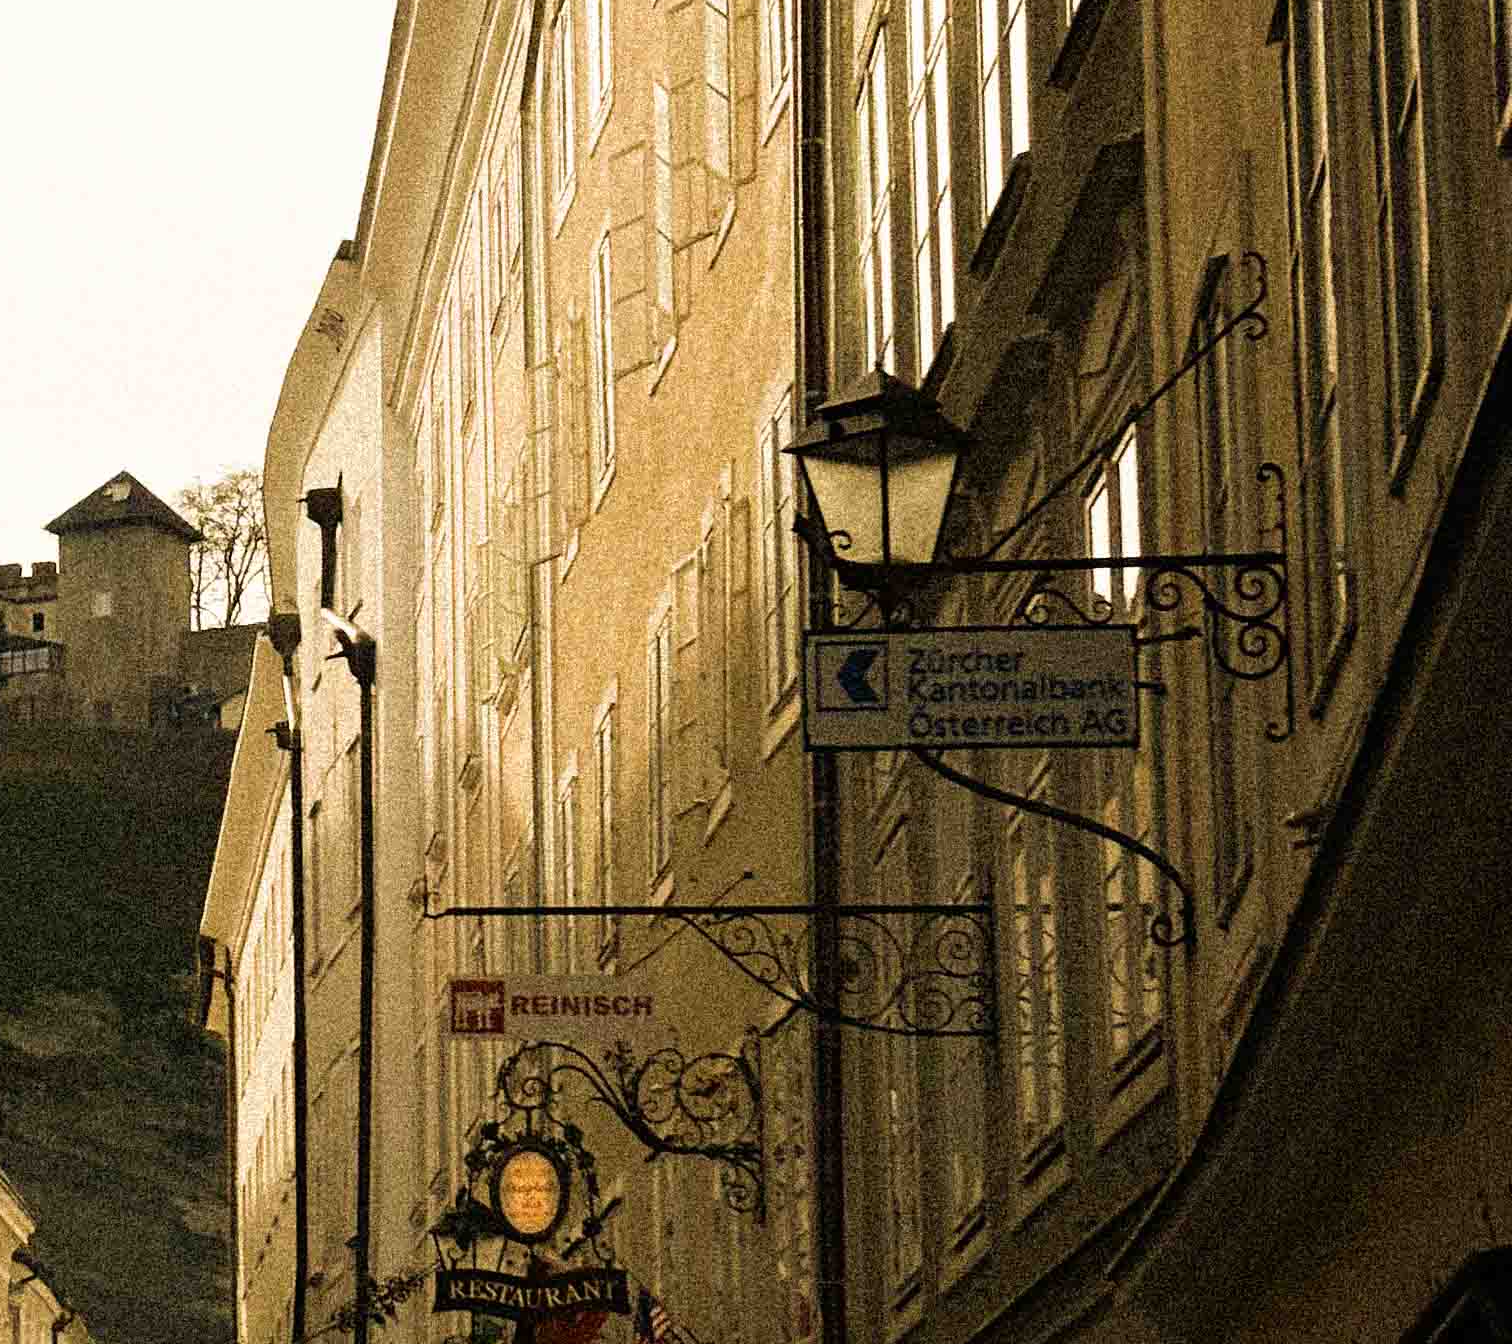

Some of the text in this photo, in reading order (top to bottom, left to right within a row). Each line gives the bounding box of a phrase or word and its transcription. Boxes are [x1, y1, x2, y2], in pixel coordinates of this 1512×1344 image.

[907, 647, 1025, 674] Zürcher
[906, 673, 1126, 702] Kantonalbank
[907, 706, 1128, 738] Österreich AG
[511, 995, 654, 1017] REINISCH
[448, 1278, 620, 1308] RESTAURANT
